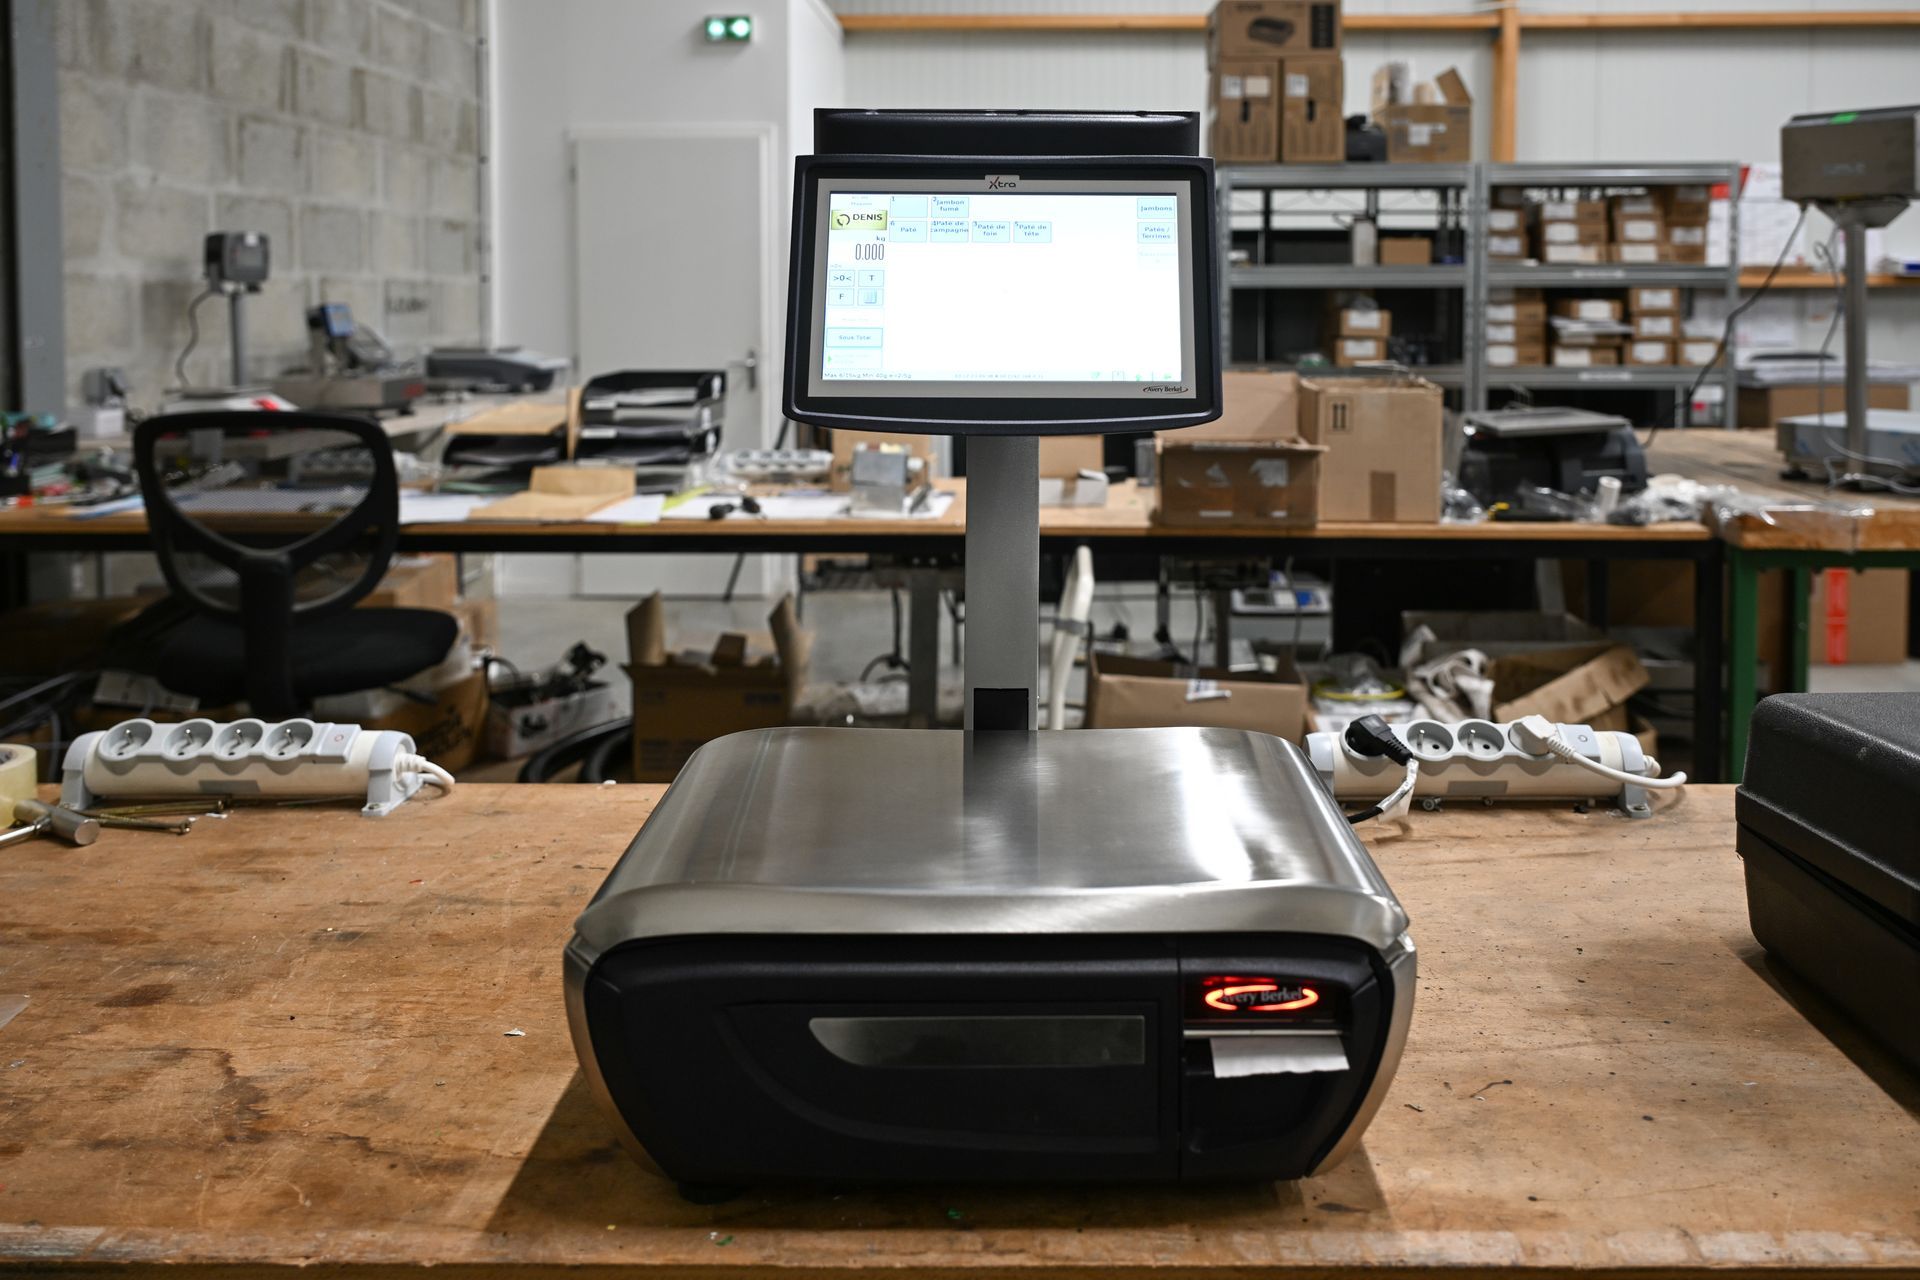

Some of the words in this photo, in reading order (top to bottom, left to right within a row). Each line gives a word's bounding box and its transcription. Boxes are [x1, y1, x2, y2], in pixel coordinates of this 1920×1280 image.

[989, 176, 1016, 189] Xtra
[852, 213, 883, 221] DENIS
[855, 243, 885, 261] 0.000
